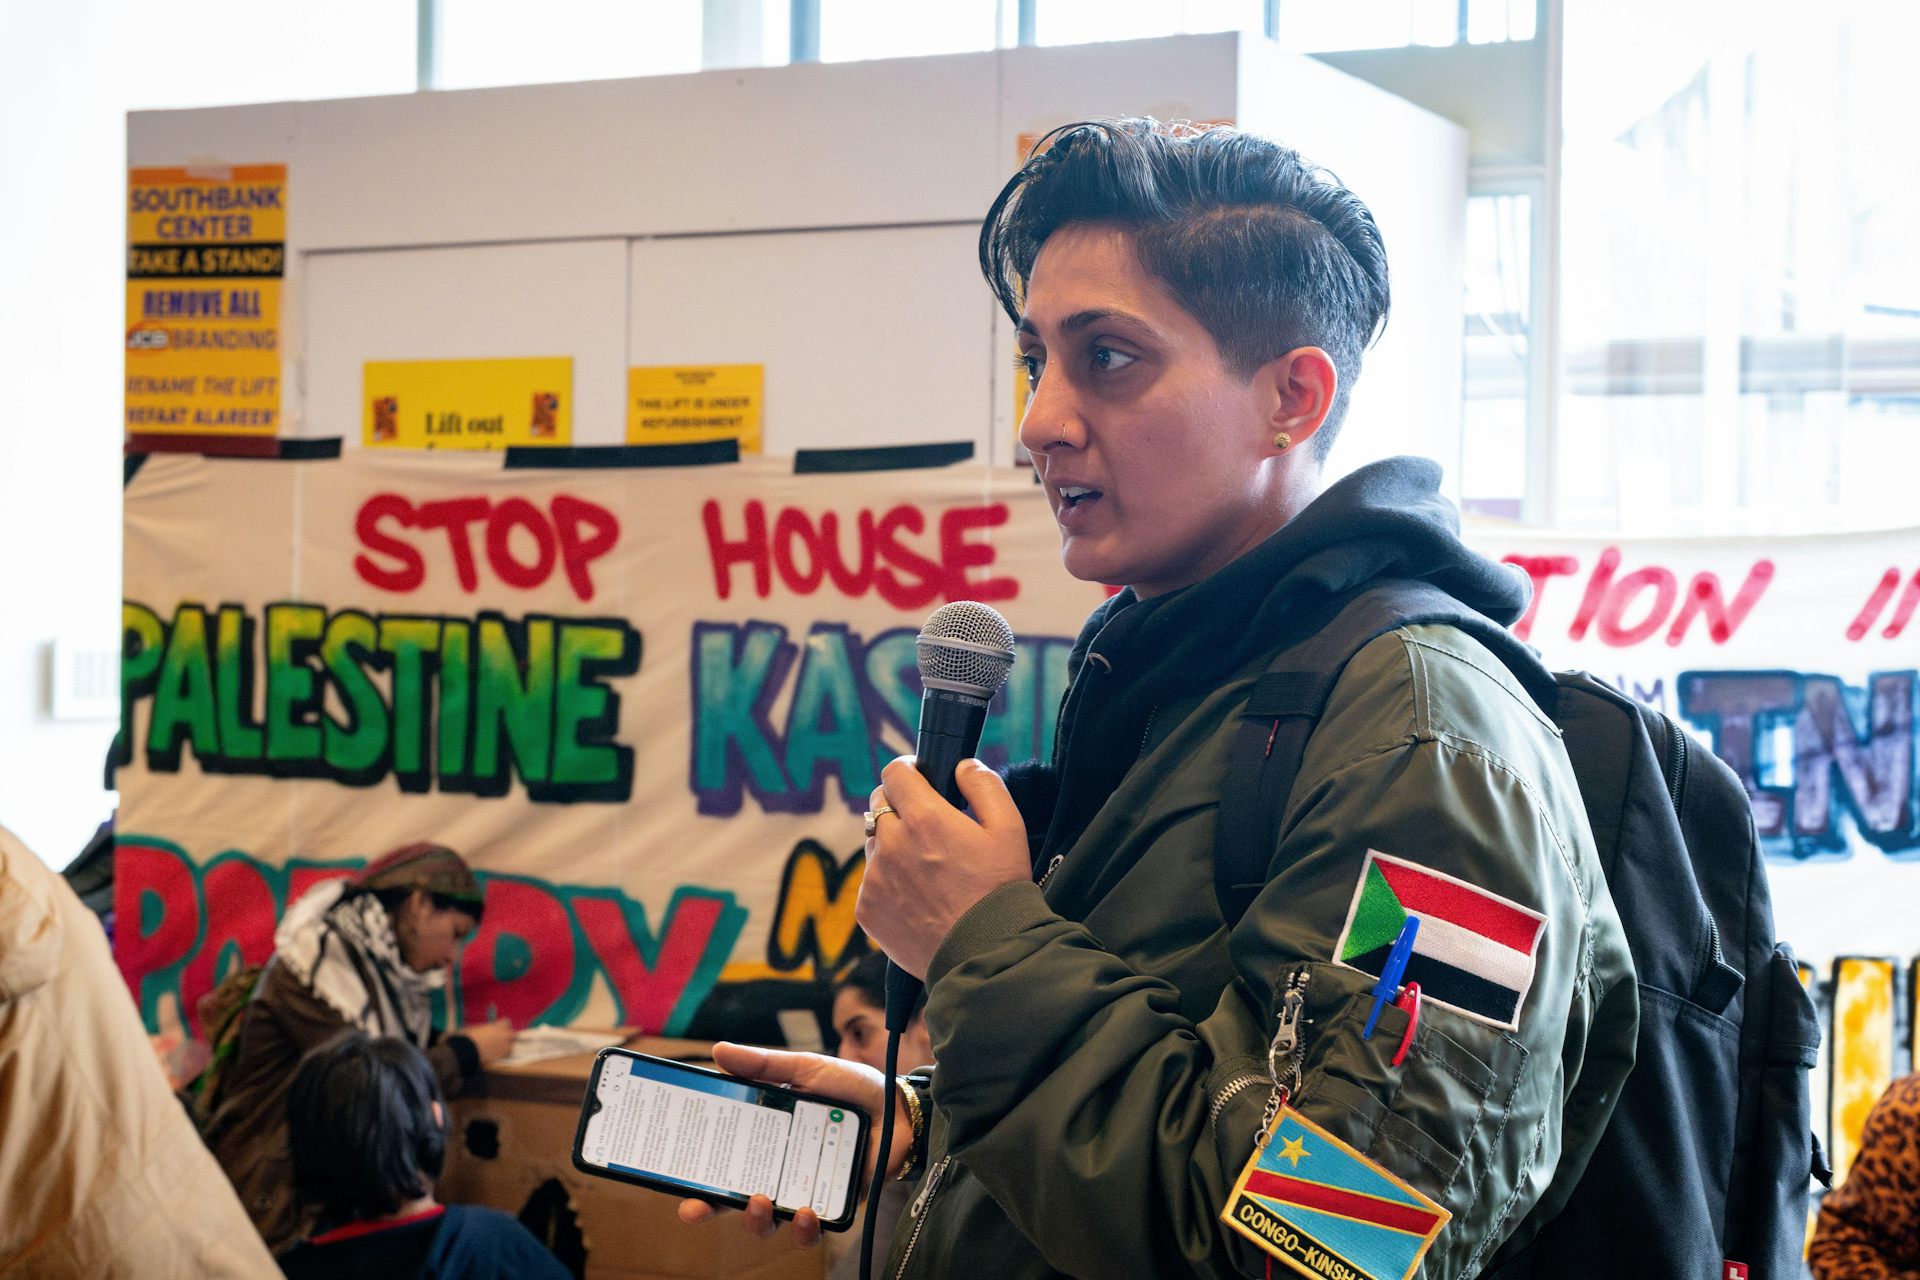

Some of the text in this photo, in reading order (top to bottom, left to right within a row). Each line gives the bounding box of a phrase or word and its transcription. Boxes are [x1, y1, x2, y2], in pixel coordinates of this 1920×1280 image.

[131, 186, 281, 213] SOUTHBANK
[156, 214, 253, 239] CENTER
[129, 248, 283, 273] TAKE A STAND!
[143, 290, 261, 318] REMOVE ALL
[172, 328, 277, 351] BRANDING
[203, 376, 234, 396] THE
[240, 376, 277, 396] LIFT
[426, 411, 504, 435] Lift out
[354, 492, 621, 602] STOP
[702, 499, 1020, 611] HOUSE
[1500, 545, 1776, 649] TION
[117, 598, 643, 804] PALESTINE
[1240, 1204, 1367, 1280] CONGO-KINSH
